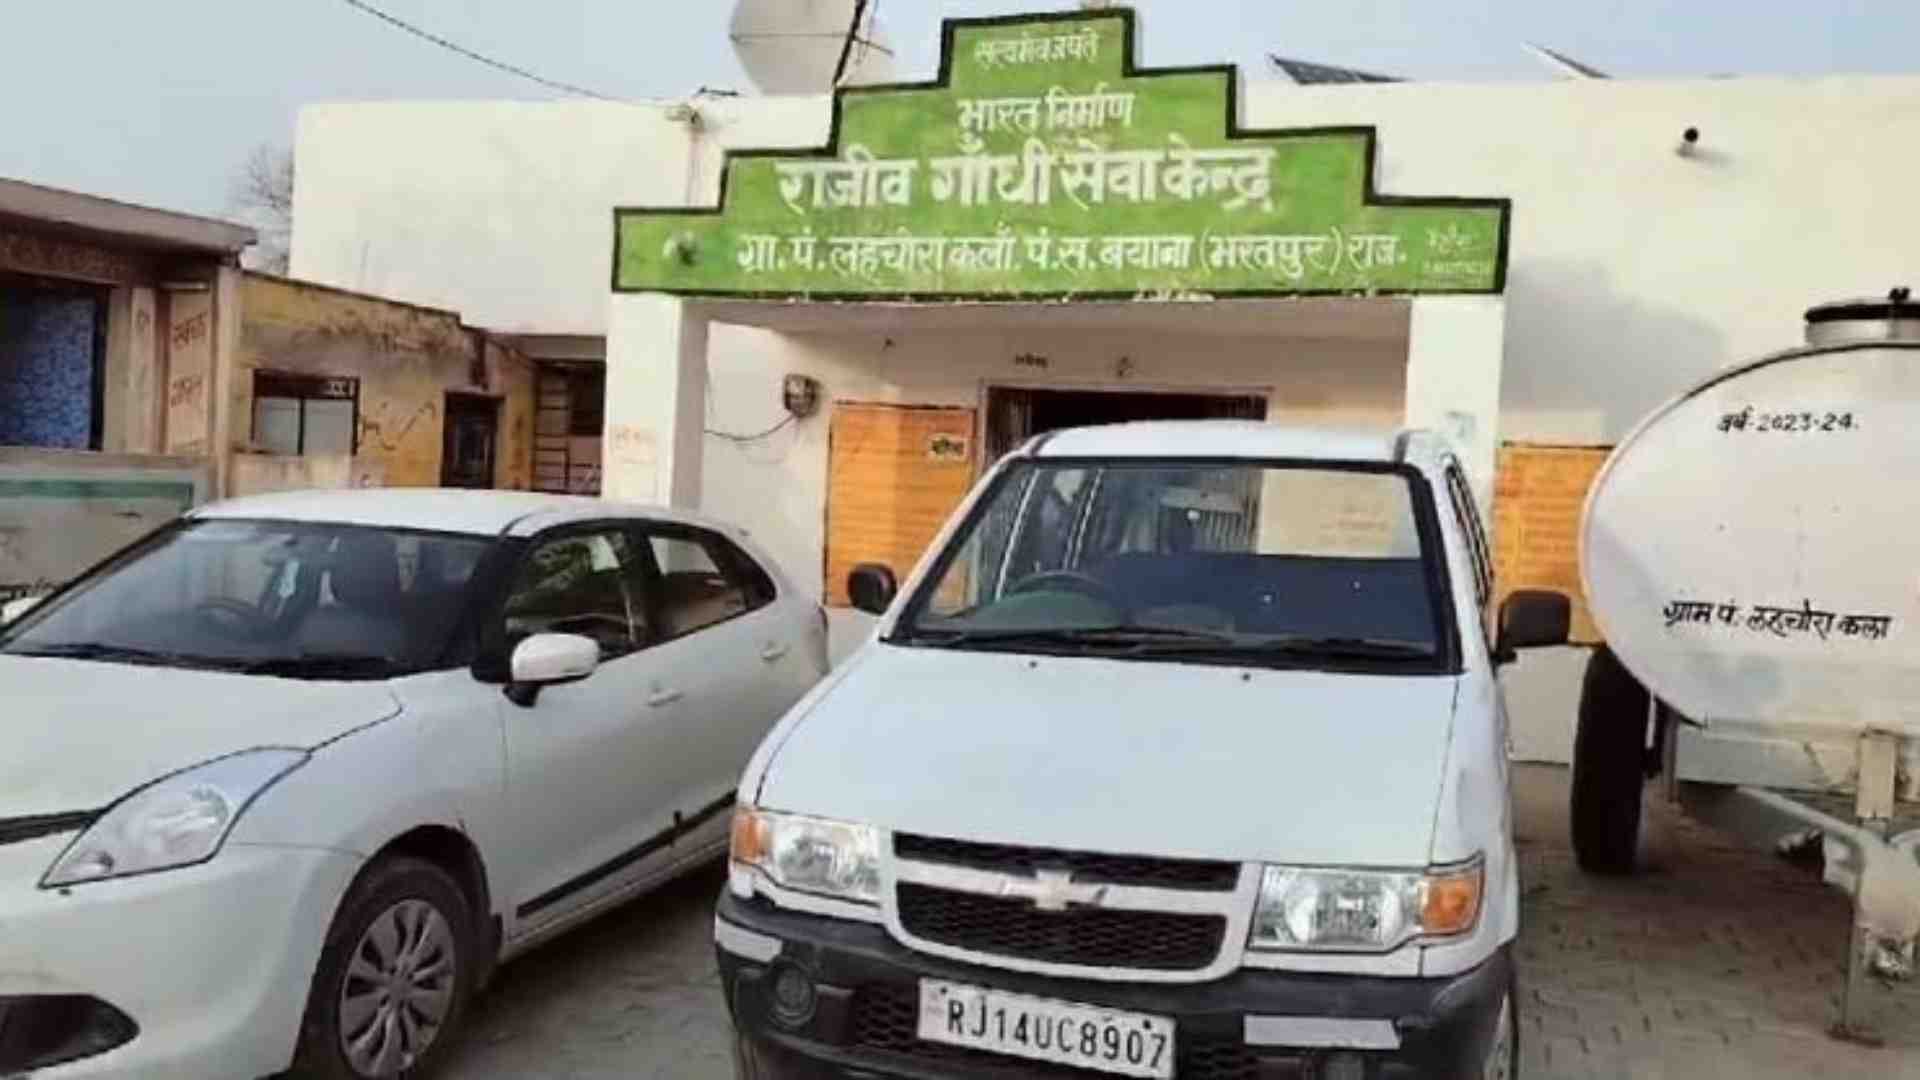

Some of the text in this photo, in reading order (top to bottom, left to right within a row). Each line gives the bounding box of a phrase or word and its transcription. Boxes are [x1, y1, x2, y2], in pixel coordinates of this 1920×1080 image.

[957, 81, 1136, 134] भारत निर्माण
[774, 144, 918, 214] राजीव
[1059, 137, 1166, 211] सेवा
[1162, 132, 1277, 212] केन्द्र
[1099, 234, 1195, 270] बयाना
[1663, 599, 1715, 627] ग्राम
[1837, 614, 1893, 640] कला
[947, 994, 1168, 1068] RJ14UC8907
